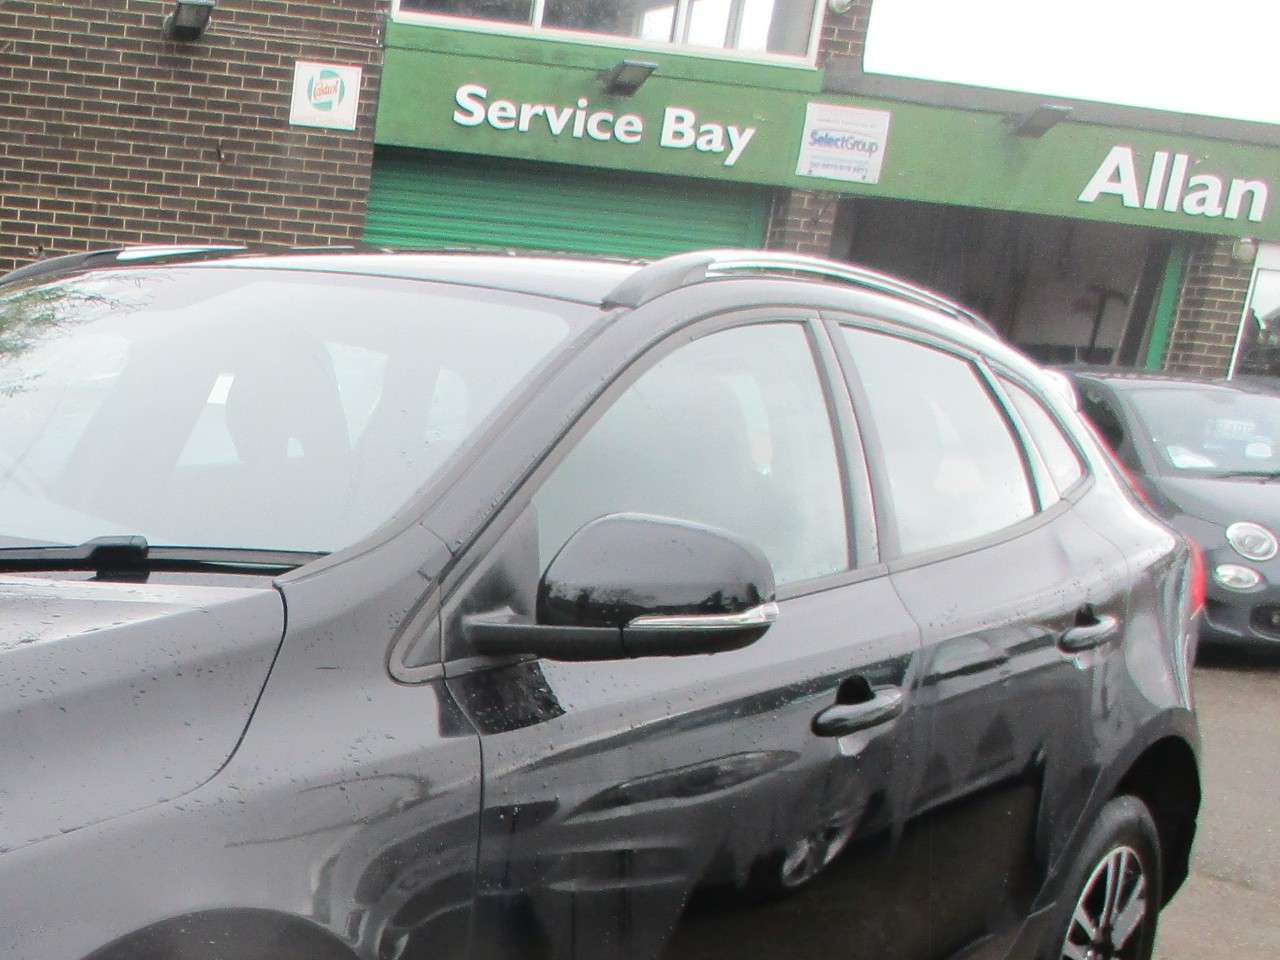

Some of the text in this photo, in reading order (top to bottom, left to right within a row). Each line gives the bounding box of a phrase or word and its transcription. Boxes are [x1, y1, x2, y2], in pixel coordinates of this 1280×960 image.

[453, 83, 756, 167] Service Bay
[1077, 145, 1269, 222] Allan
